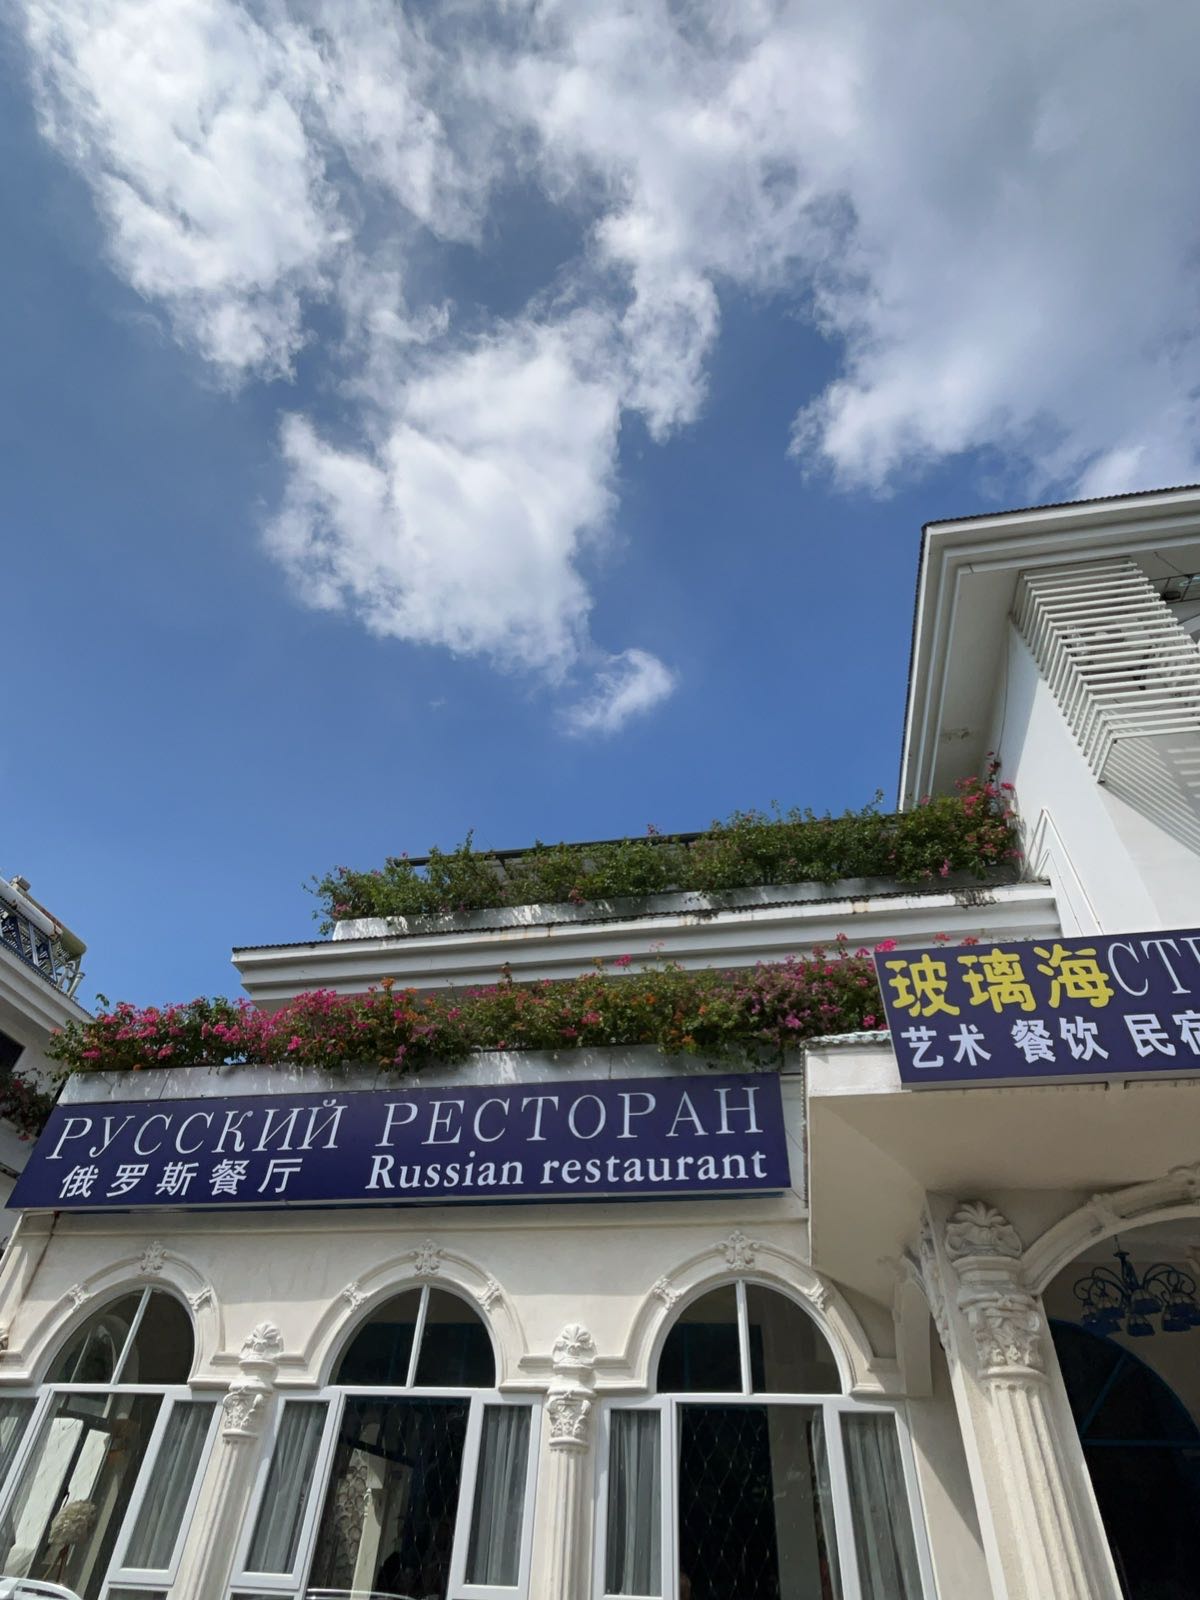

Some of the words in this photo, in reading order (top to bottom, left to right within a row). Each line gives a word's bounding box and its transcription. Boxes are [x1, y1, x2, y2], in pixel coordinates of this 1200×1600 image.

[884, 943, 1114, 1017] 玻璃海
[900, 1023, 992, 1069] 艺术
[1010, 1015, 1109, 1064] 餐饮
[374, 1086, 764, 1148] РЕСТОРАН
[58, 1157, 303, 1199] 俄罗斯餐厅
[364, 1150, 524, 1190] Russian
[540, 1150, 768, 1185] restaurant
